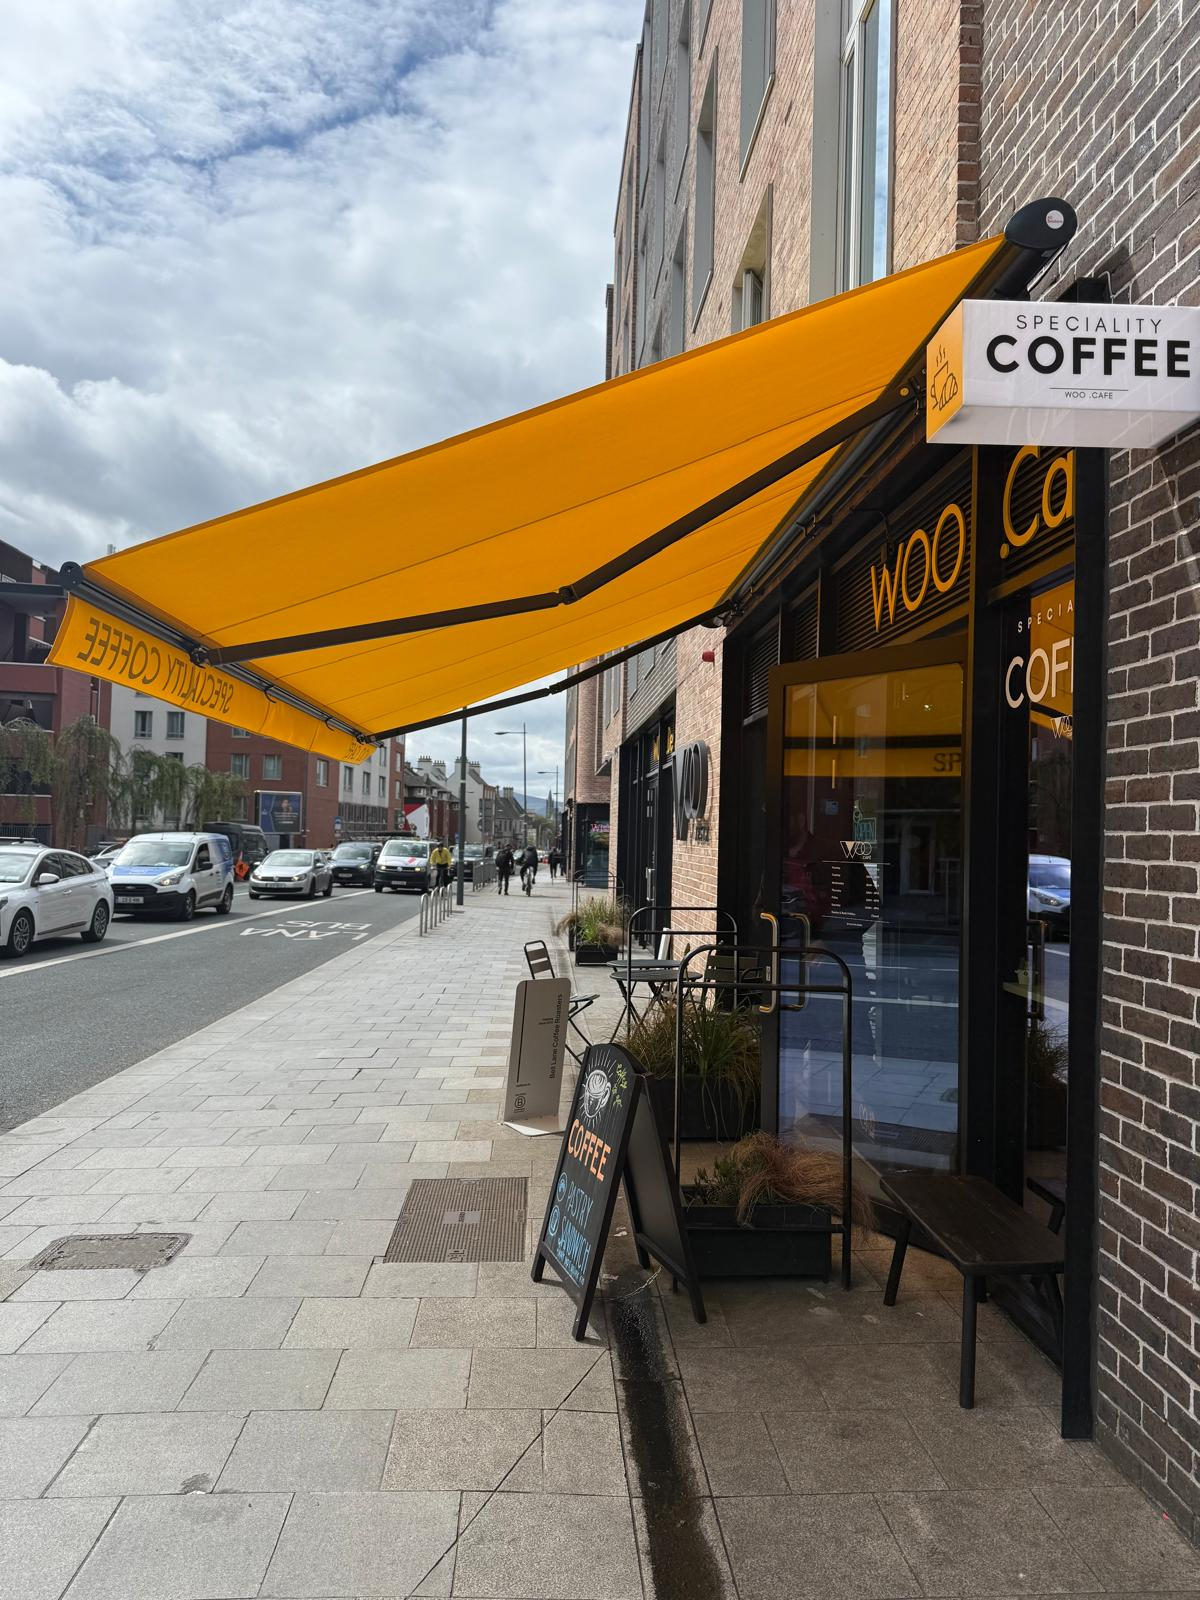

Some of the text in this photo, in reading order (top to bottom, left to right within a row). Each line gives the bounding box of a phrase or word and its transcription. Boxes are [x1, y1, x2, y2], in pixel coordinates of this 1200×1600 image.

[1016, 314, 1163, 334] SPECIALITY
[986, 334, 1191, 378] COFFEE
[1064, 391, 1087, 399] WOO
[870, 503, 967, 633] WOO
[1017, 599, 1074, 633] SPECIA
[1005, 637, 1074, 709] COF
[276, 920, 373, 931] BUS
[554, 993, 563, 1023] Roasters
[552, 1023, 560, 1048] Coffee
[567, 1119, 612, 1182] COFFEE
[565, 1181, 594, 1230] PASTRY
[557, 1215, 592, 1275] SANDWICH
